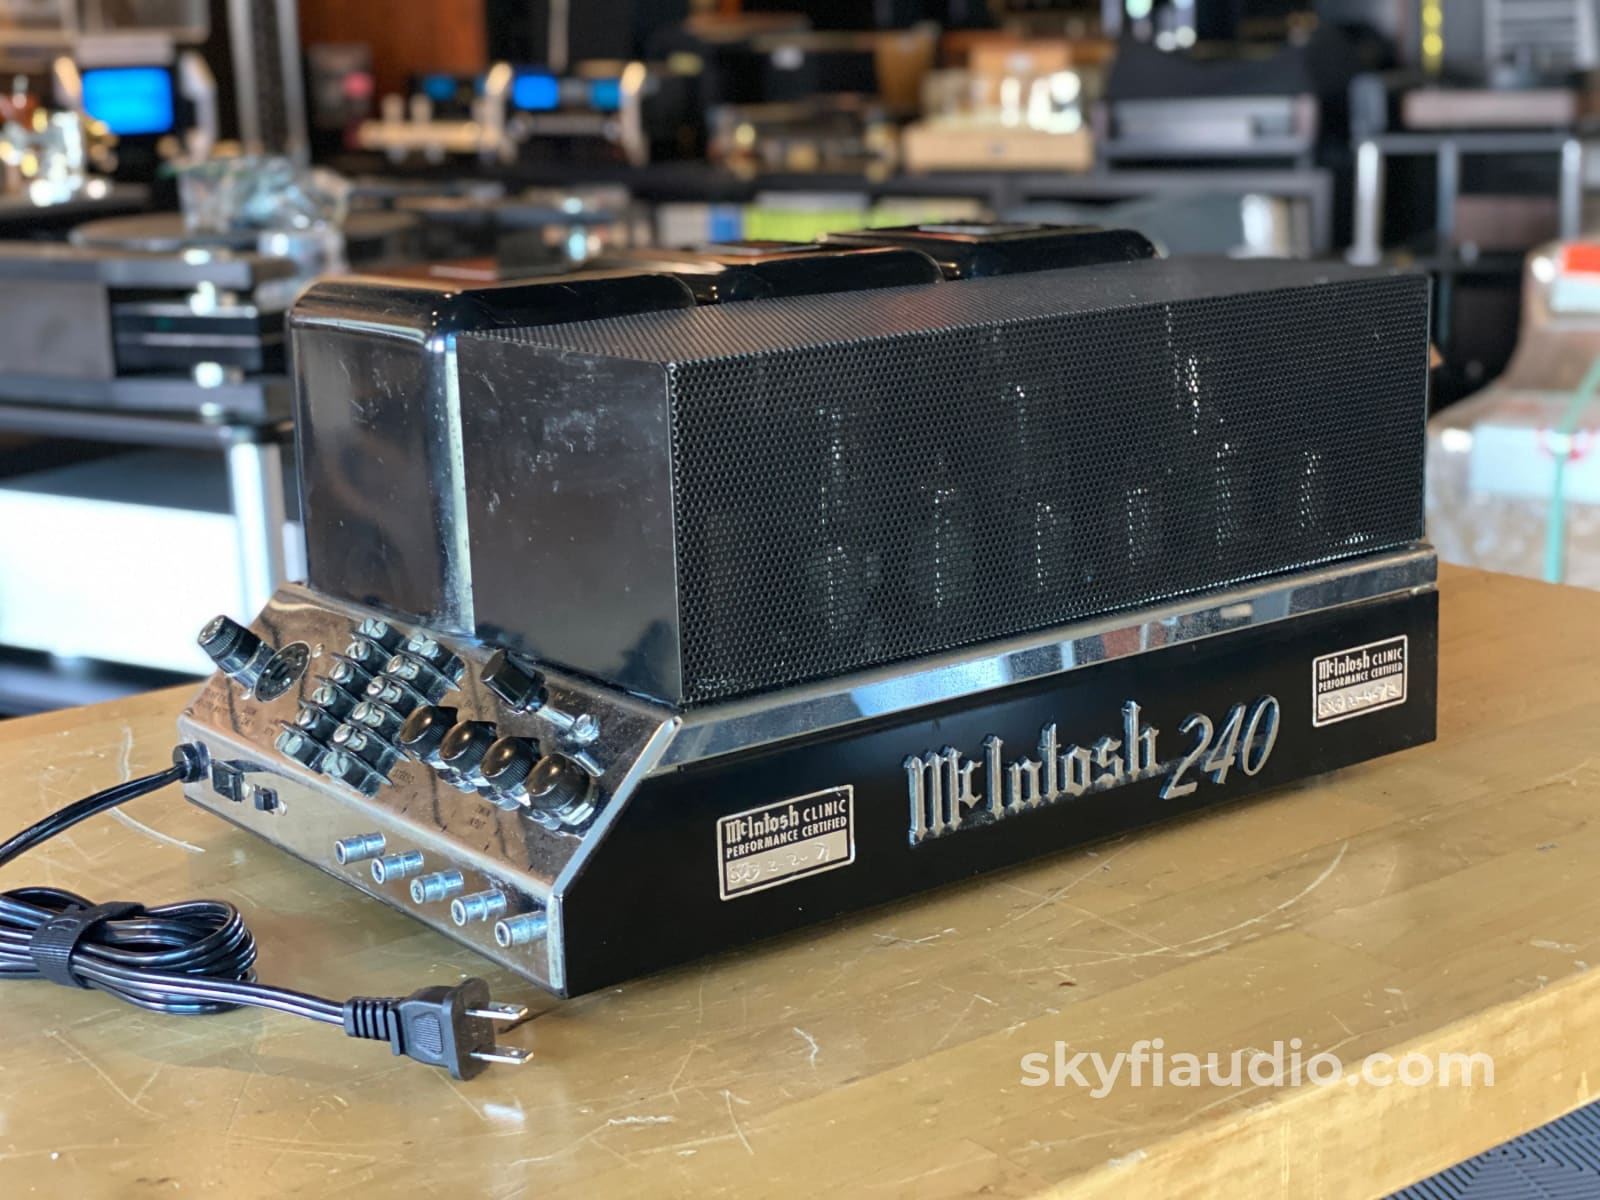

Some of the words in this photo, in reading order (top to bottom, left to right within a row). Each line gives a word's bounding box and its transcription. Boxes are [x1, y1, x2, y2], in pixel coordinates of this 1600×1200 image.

[1318, 649, 1370, 680] McIntosh
[1372, 647, 1403, 666] CLINIC
[1318, 670, 1369, 693] PERFORMANCE
[1371, 662, 1403, 679] CERTIFIED
[904, 699, 1159, 848] McIntosh
[1159, 694, 1281, 800] 240
[725, 804, 800, 845] McIntosh
[802, 799, 847, 823] CLINIC
[726, 828, 799, 859] PERFORMANCE
[802, 816, 848, 838] CERTIFIED
